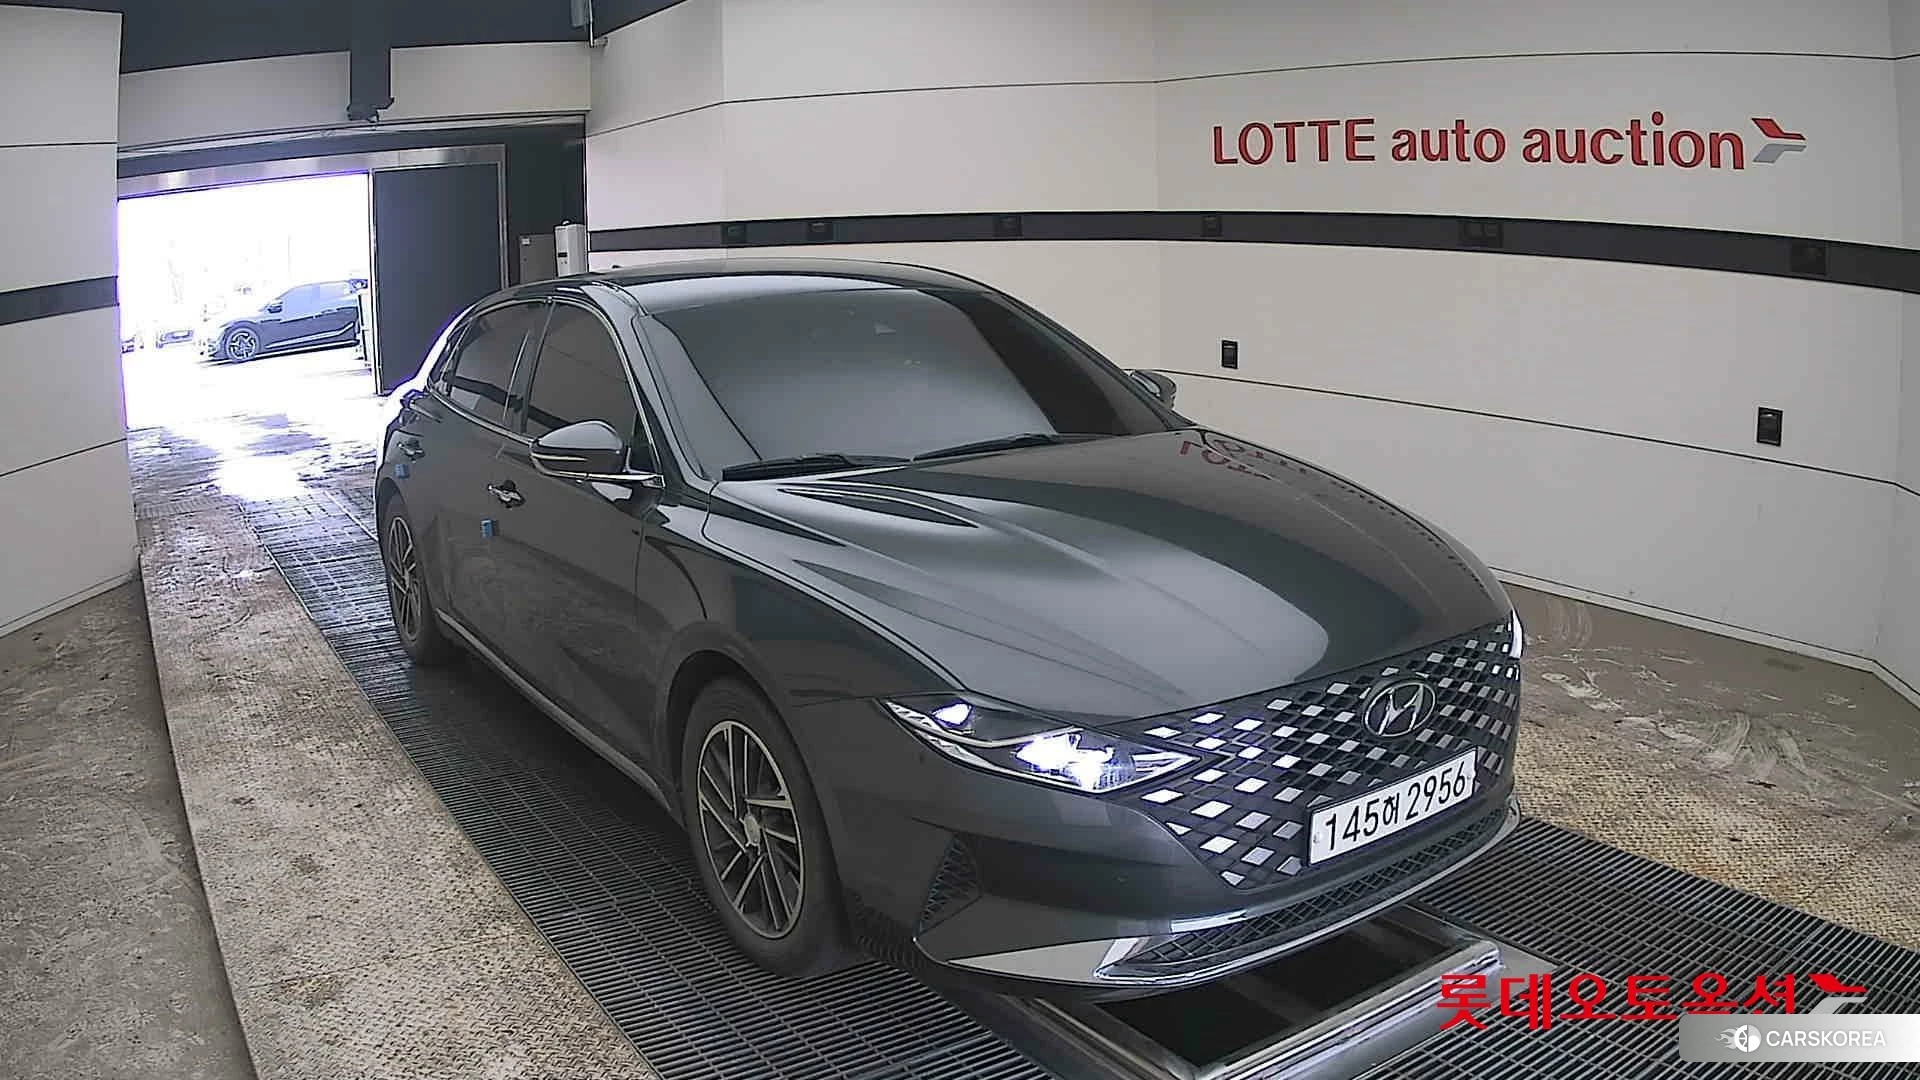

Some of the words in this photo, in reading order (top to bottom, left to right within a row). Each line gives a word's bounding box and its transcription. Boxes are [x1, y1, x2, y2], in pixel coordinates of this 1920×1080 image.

[1213, 118, 1376, 165] LOTTE
[1391, 119, 1506, 163] auto
[1522, 111, 1744, 170] auction
[1325, 792, 1400, 851] 145허
[1405, 761, 1466, 821] 2956
